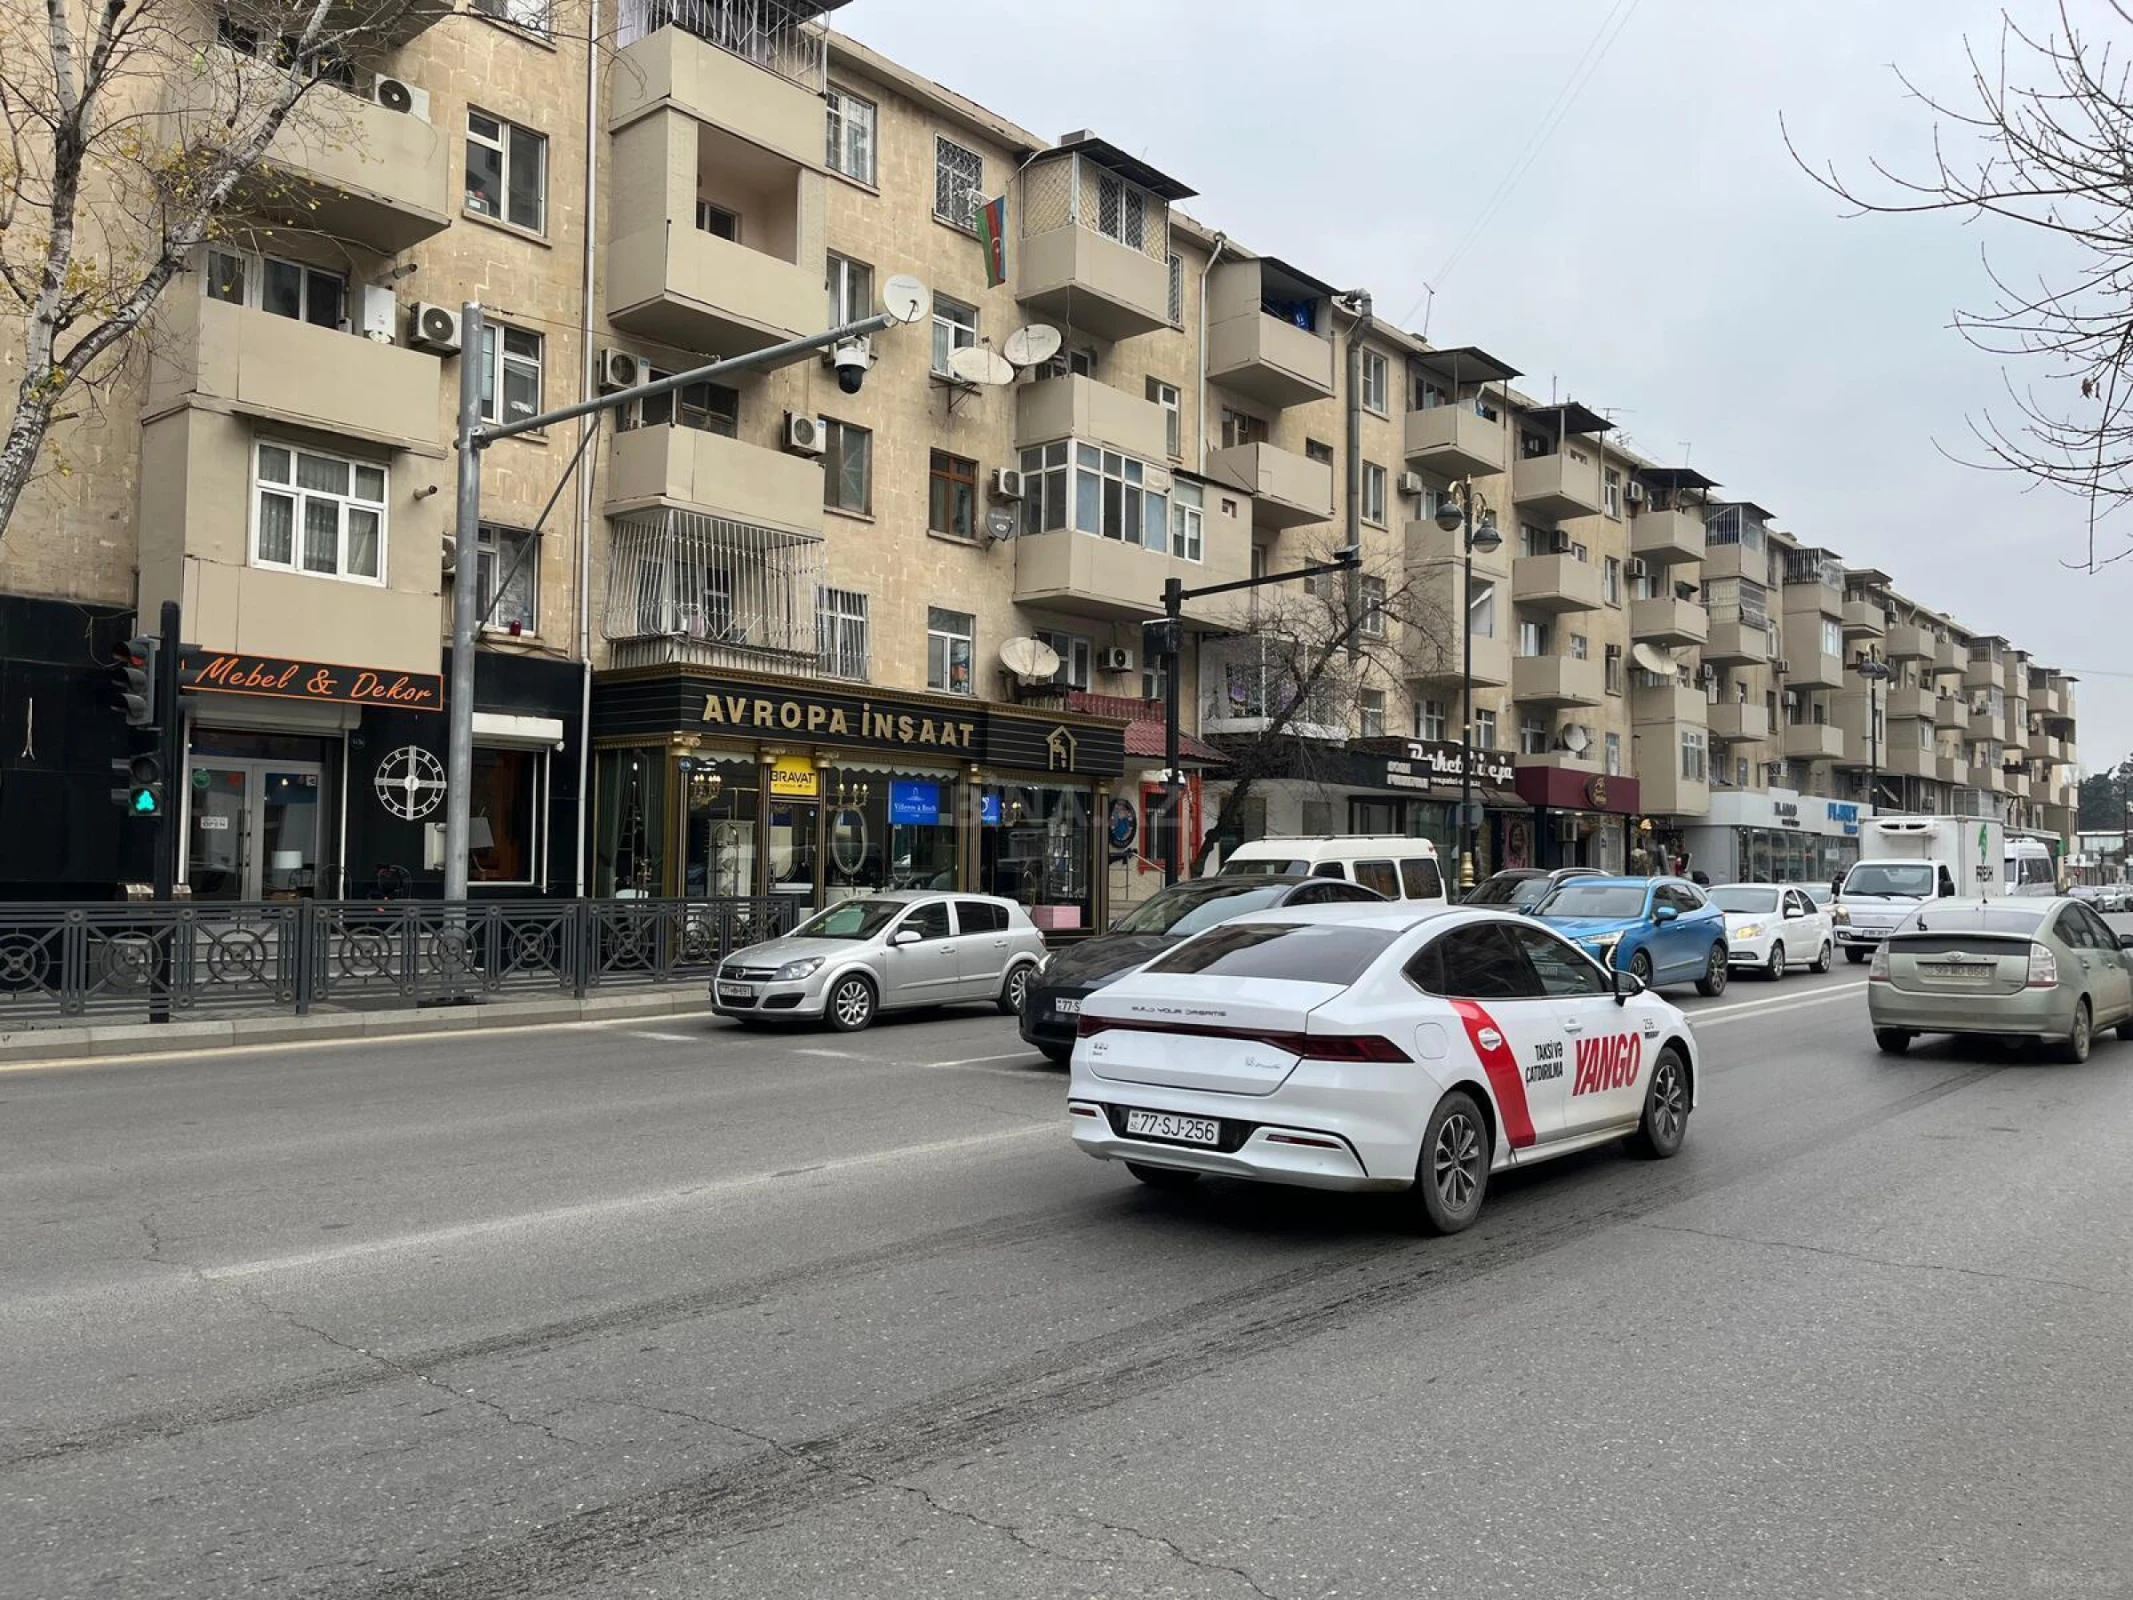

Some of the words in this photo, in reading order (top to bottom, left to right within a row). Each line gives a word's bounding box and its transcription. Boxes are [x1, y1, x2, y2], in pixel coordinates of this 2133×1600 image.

[195, 656, 300, 690] Mebel
[306, 669, 339, 694] &
[350, 672, 434, 702] Dekor
[702, 694, 848, 735] AVROPA
[861, 702, 974, 748] İNŞAAT
[769, 770, 815, 784] BRAVAT
[1534, 1039, 1554, 1061] TAKSİ
[1572, 1031, 1641, 1097] YANGO
